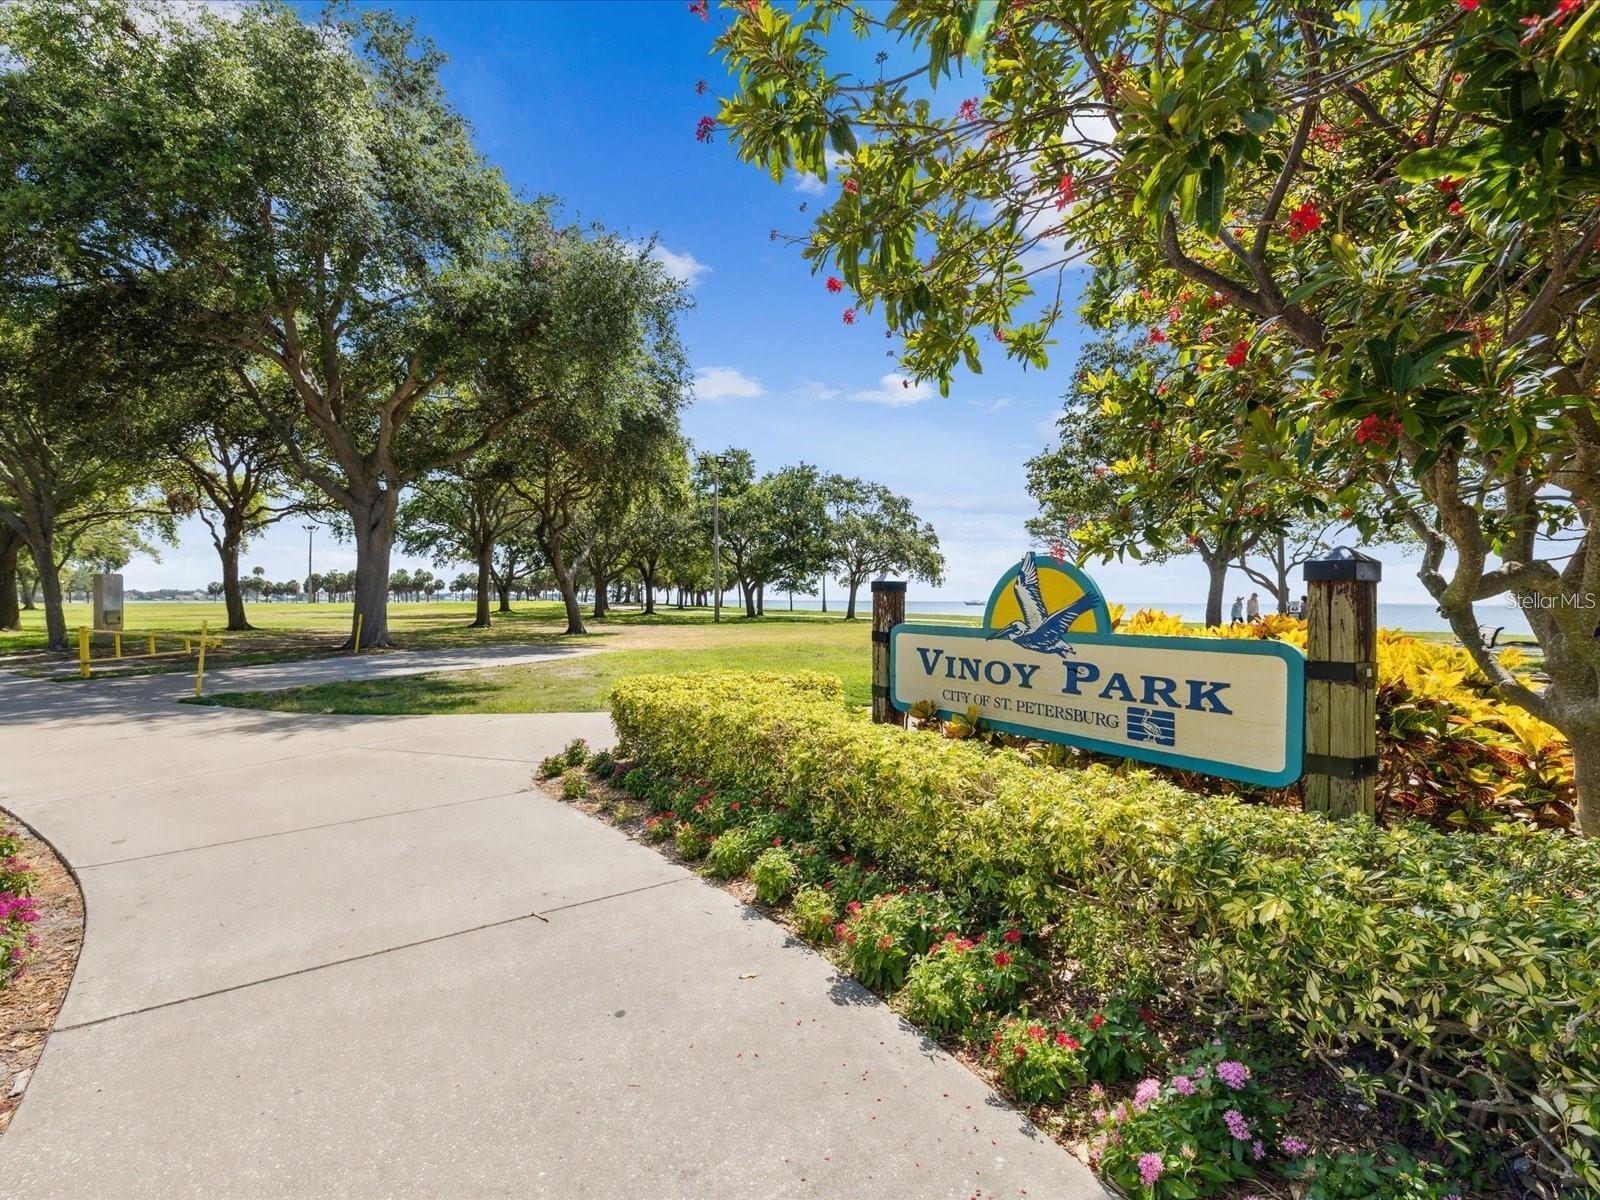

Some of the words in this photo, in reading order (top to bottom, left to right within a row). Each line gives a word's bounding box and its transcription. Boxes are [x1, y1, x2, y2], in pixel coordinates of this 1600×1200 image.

[916, 648, 1041, 689] VINOY
[1061, 660, 1233, 715] PARK
[942, 689, 972, 704] CITY
[973, 693, 991, 707] OF
[993, 696, 1012, 711] ST.
[1016, 700, 1119, 729] PETERSBURG
